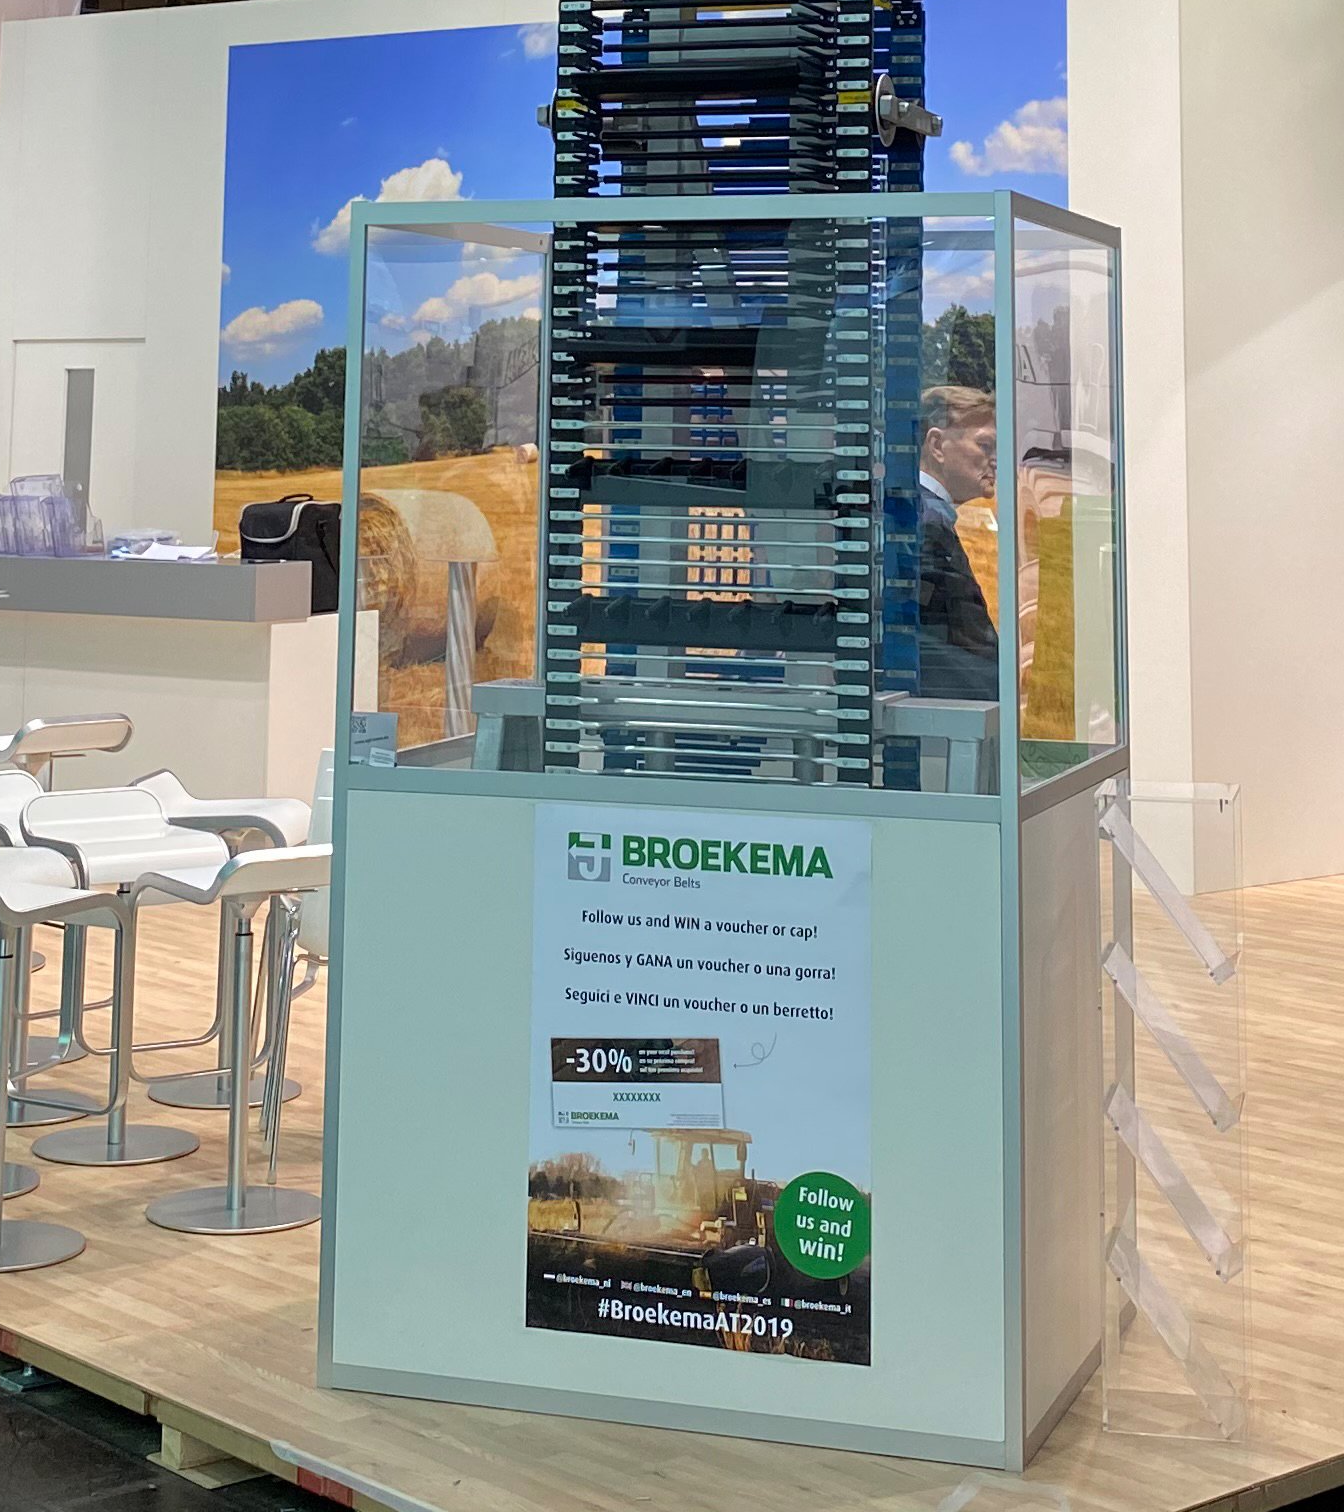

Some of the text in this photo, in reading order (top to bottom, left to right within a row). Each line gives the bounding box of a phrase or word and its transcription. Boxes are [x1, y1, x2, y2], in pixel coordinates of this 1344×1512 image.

[622, 835, 834, 879] BROEKEMA
[622, 872, 701, 889] Conveyor Belts
[582, 910, 818, 942] Follow us and WIN a voucher or cap!
[625, 955, 632, 969] y
[636, 953, 673, 969] GANA
[676, 958, 694, 970] un
[697, 957, 750, 974] voucher
[754, 963, 762, 975] o
[766, 964, 791, 977] una
[795, 967, 836, 981] gorra!
[565, 987, 834, 1020] Seguici e VINCI un voucher o un berretto!
[566, 1048, 633, 1074] -30%
[612, 1092, 661, 1102] XXXXXXXX
[571, 1111, 619, 1120] BROEKEMA
[798, 1186, 854, 1212] Follow
[796, 1214, 852, 1238] us and
[598, 1298, 793, 1338] #BroekemaAT2019
